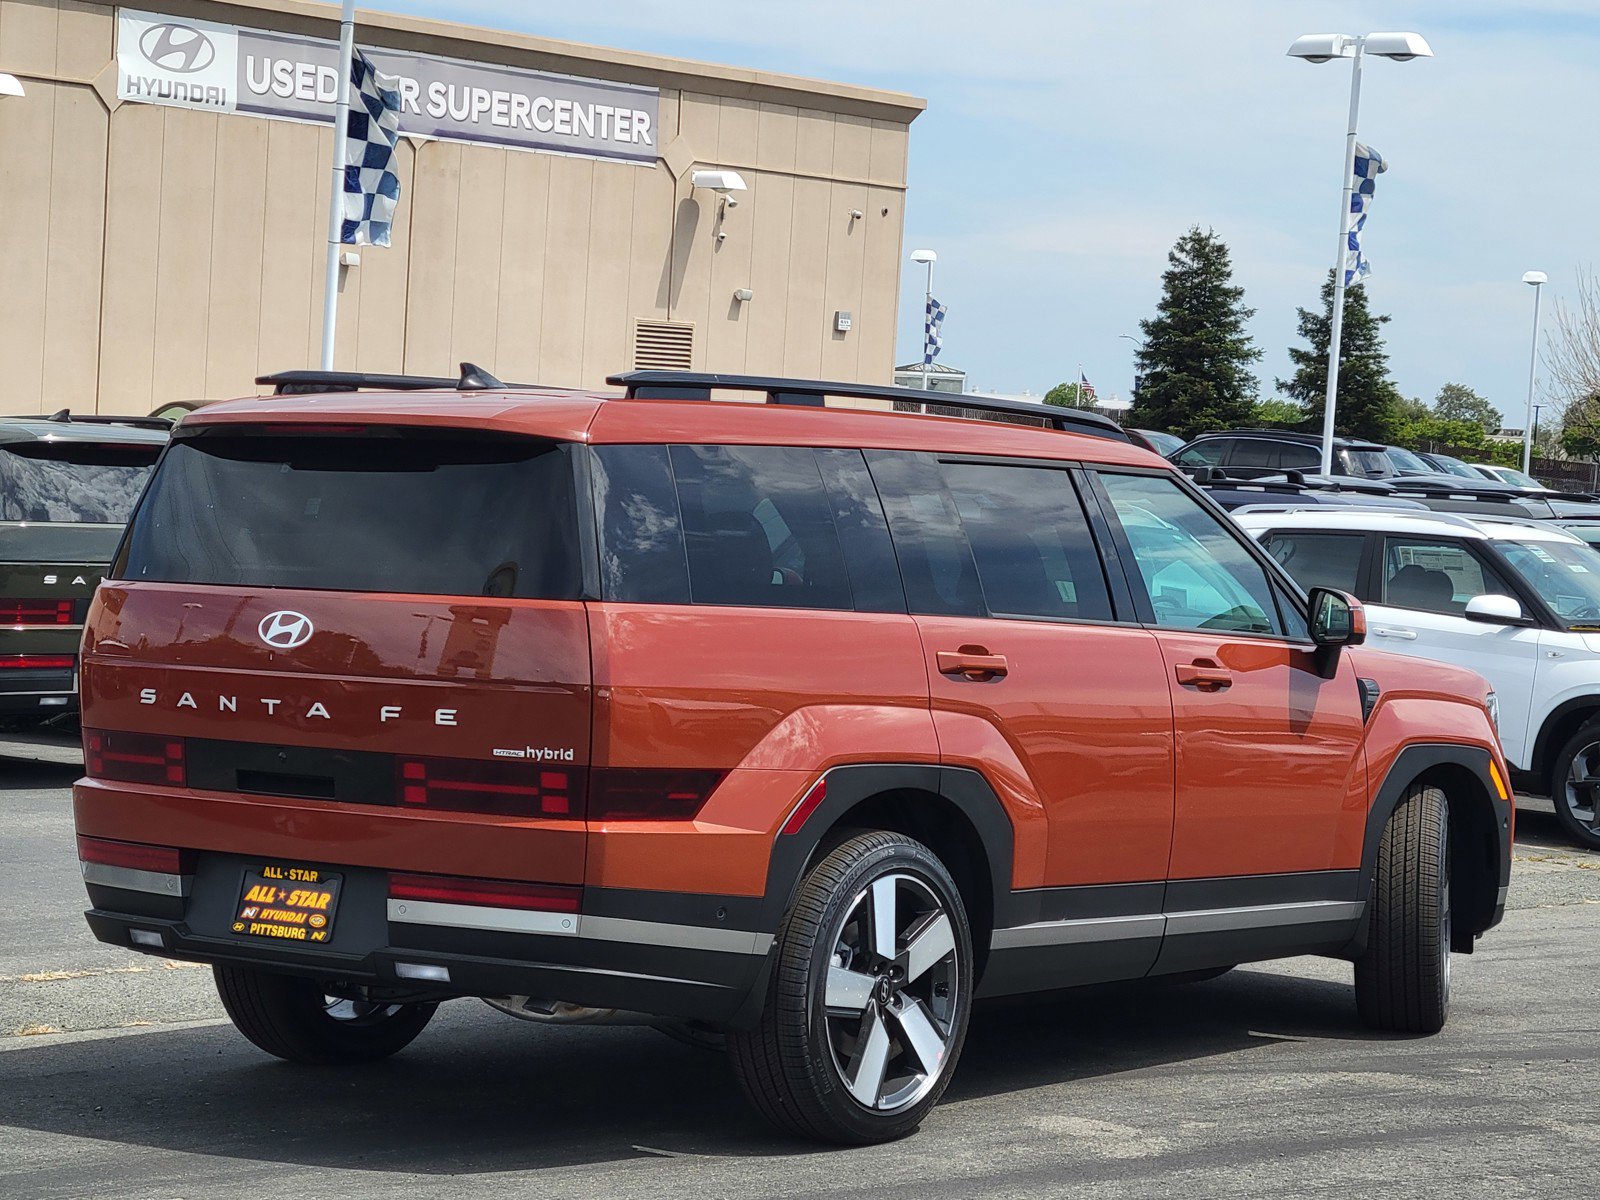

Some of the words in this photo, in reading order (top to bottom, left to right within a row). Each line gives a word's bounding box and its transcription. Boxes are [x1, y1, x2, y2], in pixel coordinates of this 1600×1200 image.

[126, 74, 227, 106] HYUNDAI
[246, 55, 340, 103] USED
[426, 80, 653, 146] SUPERCENTER
[43, 574, 105, 586] SA
[139, 687, 331, 720] SANTA
[379, 705, 458, 726] FE
[526, 746, 574, 761] hybrid
[263, 866, 283, 879] ALL
[289, 869, 318, 882] STAR
[244, 885, 277, 903] ALL
[286, 889, 331, 909] STAR
[260, 908, 308, 924] HYUNDAI
[249, 922, 306, 940] PITTSBURG
